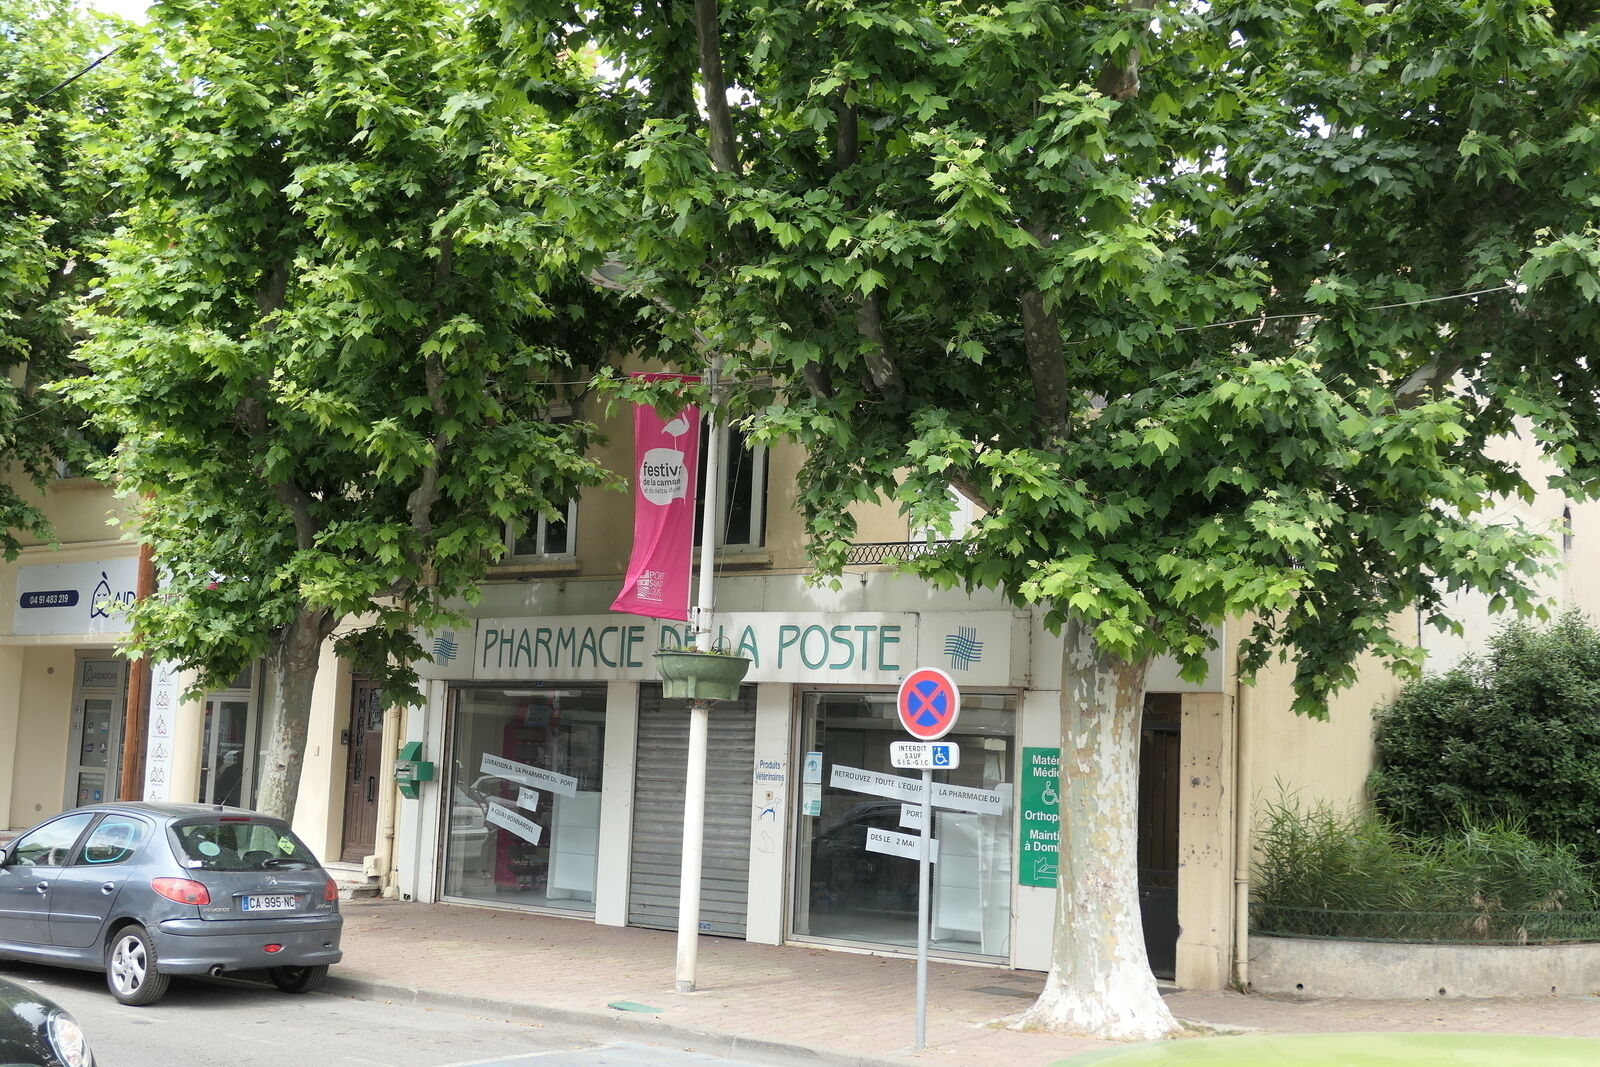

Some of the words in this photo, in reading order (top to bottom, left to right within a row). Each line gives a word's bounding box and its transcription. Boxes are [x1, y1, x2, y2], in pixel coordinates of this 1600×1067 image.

[29, 596, 38, 605] 04
[39, 595, 45, 604] 91
[46, 595, 57, 604] 483
[58, 594, 69, 603] 219
[483, 626, 645, 668] PHARMACIE
[778, 625, 901, 671] POSTE
[759, 759, 781, 770] Produits
[484, 758, 508, 770] LIVRAISON
[522, 768, 550, 781] PHARMACIE
[560, 779, 574, 788] PORT
[834, 769, 871, 783] RETROUVEZ
[875, 777, 895, 788] TOUTE
[898, 781, 923, 792] L'EQUIP
[939, 789, 948, 797] LA
[948, 790, 988, 802] PHARMACIE
[989, 796, 1001, 804] DU
[523, 792, 533, 800] SVP
[906, 809, 923, 818] PORT
[494, 809, 507, 819] QUAI
[507, 814, 534, 833] BONNARDEL
[870, 834, 883, 842] DES
[902, 839, 915, 848] MAI
[1024, 840, 1031, 851] à
[249, 896, 295, 909] CA-995-NC
